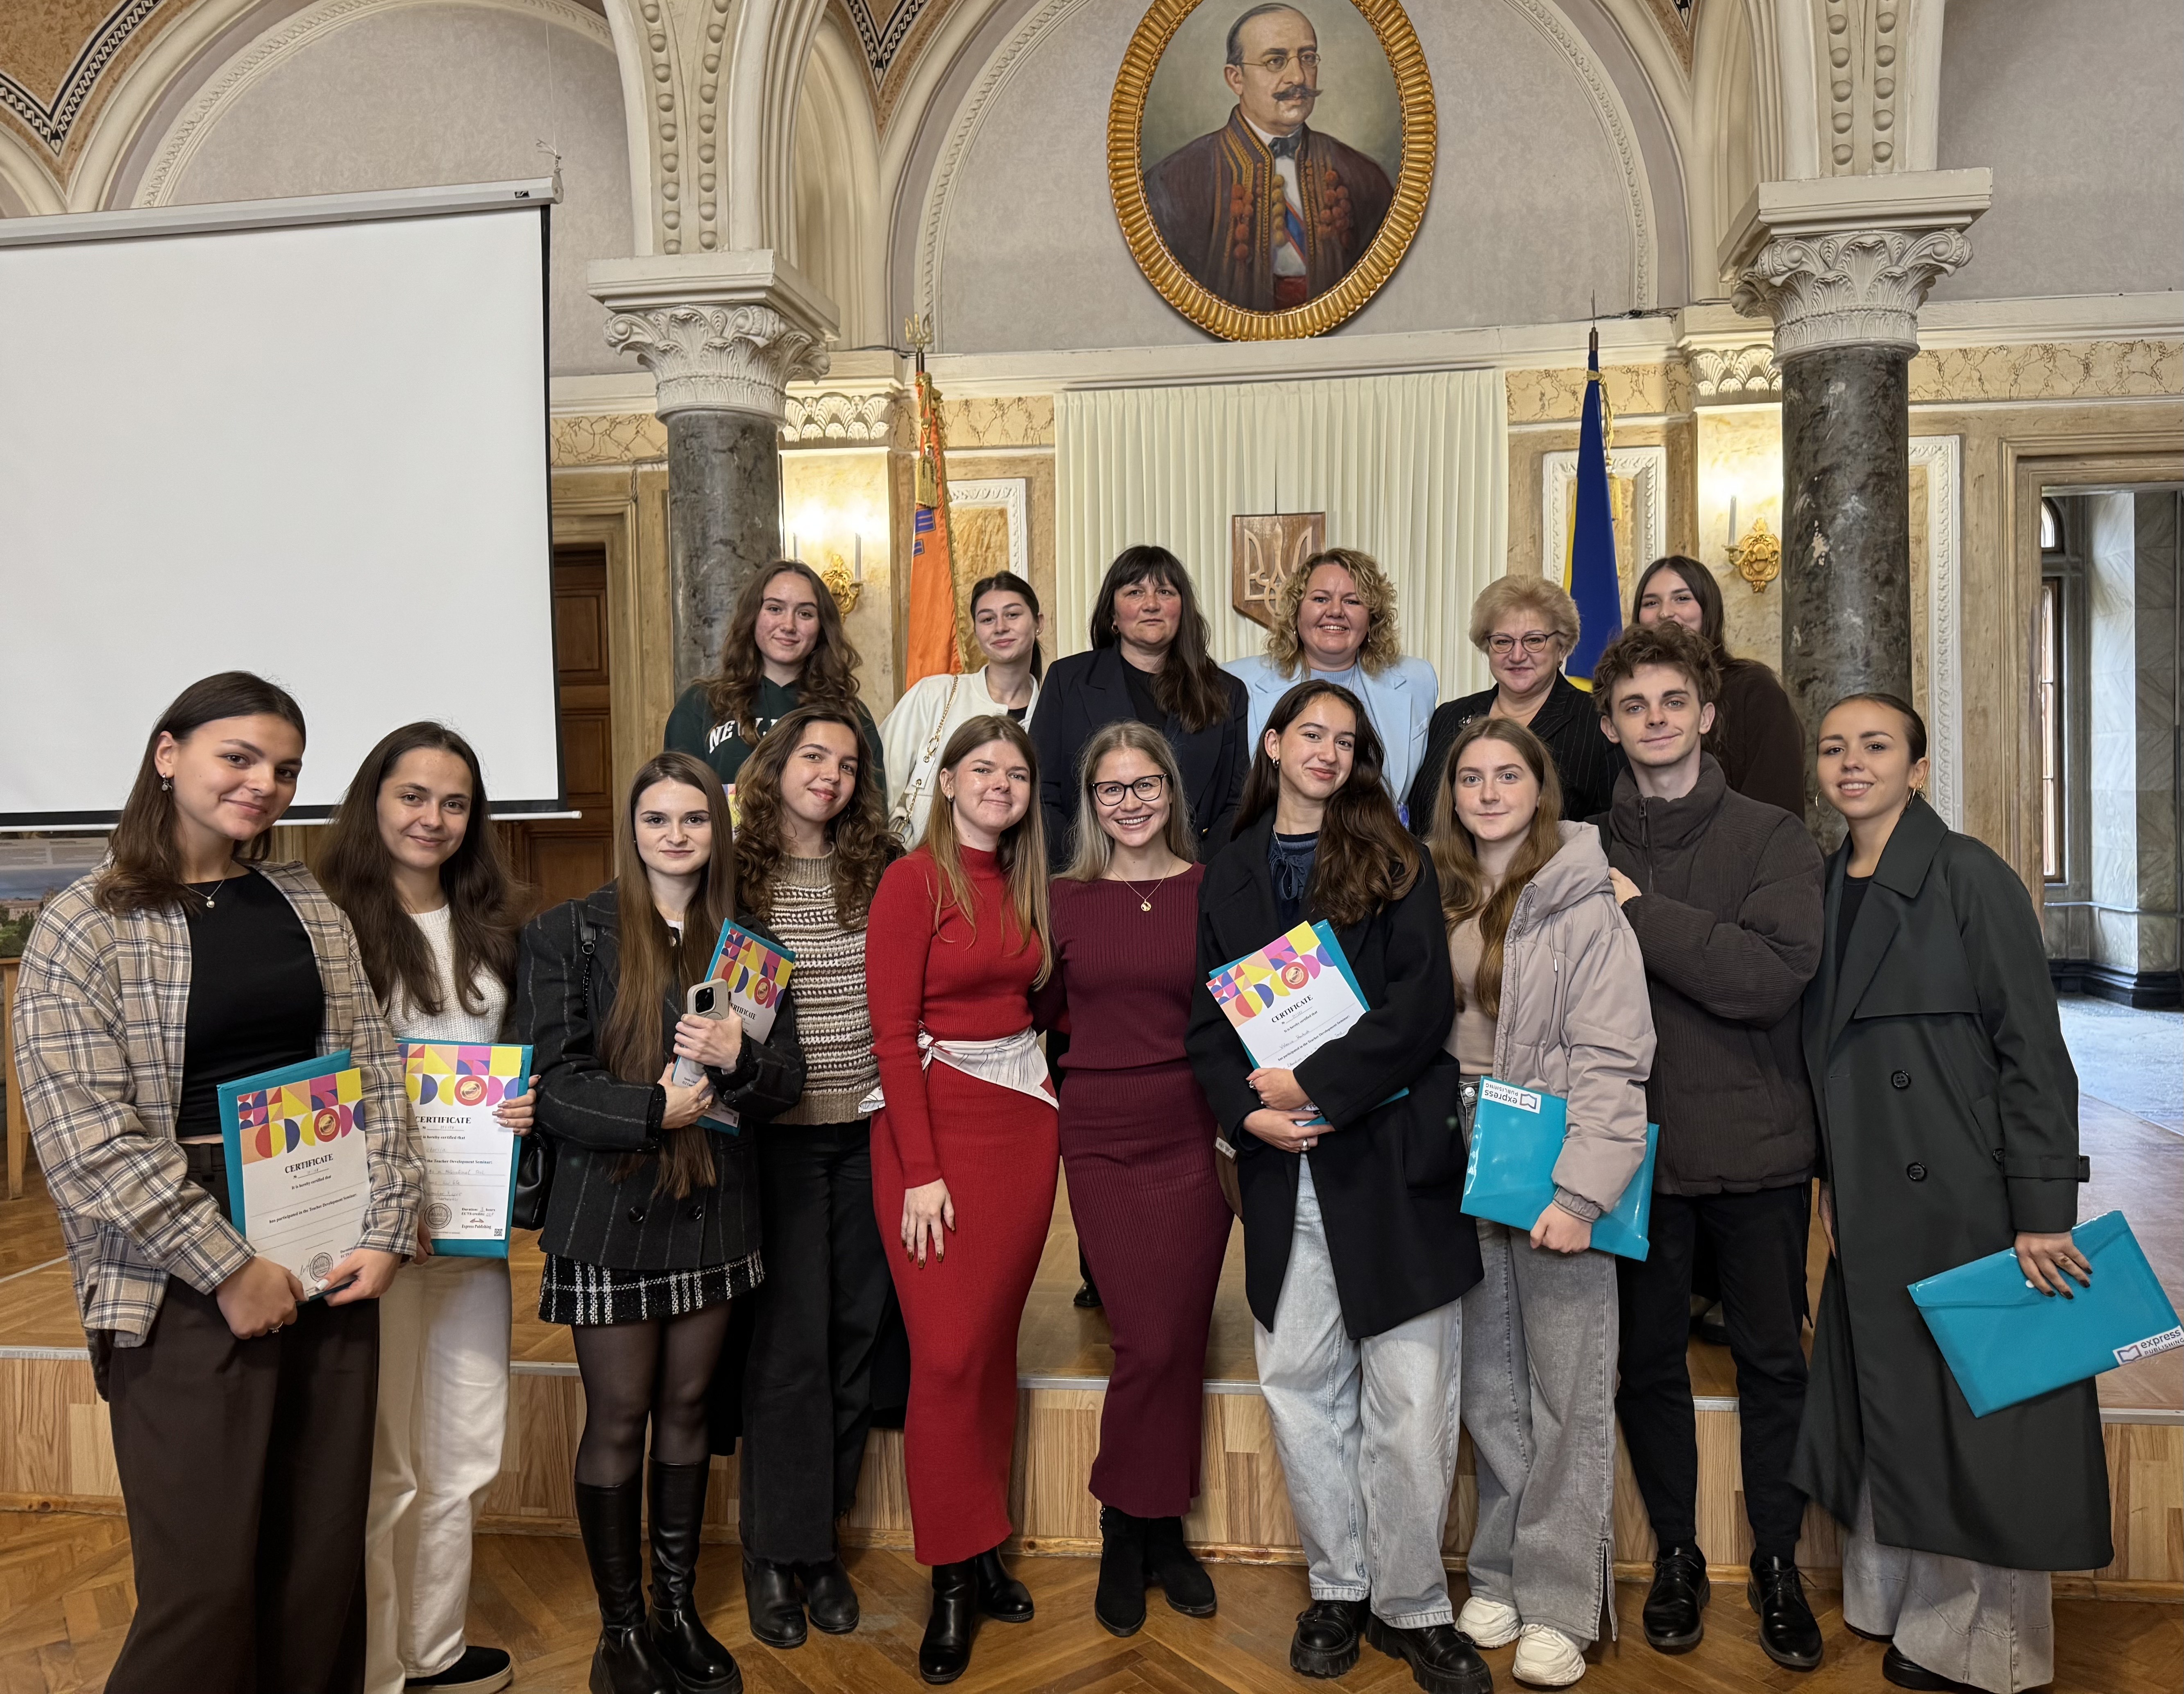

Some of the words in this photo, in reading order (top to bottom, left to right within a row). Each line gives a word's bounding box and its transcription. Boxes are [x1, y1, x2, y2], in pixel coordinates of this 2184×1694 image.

[730, 1003, 757, 1020] ERTIFICATE
[1271, 995, 1313, 1023] CERTIFICATE
[1300, 1014, 1312, 1023] certified
[1283, 1047, 1300, 1058] participated
[1319, 1023, 1337, 1036] Development
[1337, 1015, 1350, 1024] Seminar:
[1484, 1090, 1517, 1104] express
[1485, 1083, 1518, 1096] PUBLISHING
[285, 1153, 333, 1174] CERTIFICATE
[277, 1212, 298, 1222] participated
[322, 1198, 343, 1207] Development
[2141, 1329, 2181, 1349] express
